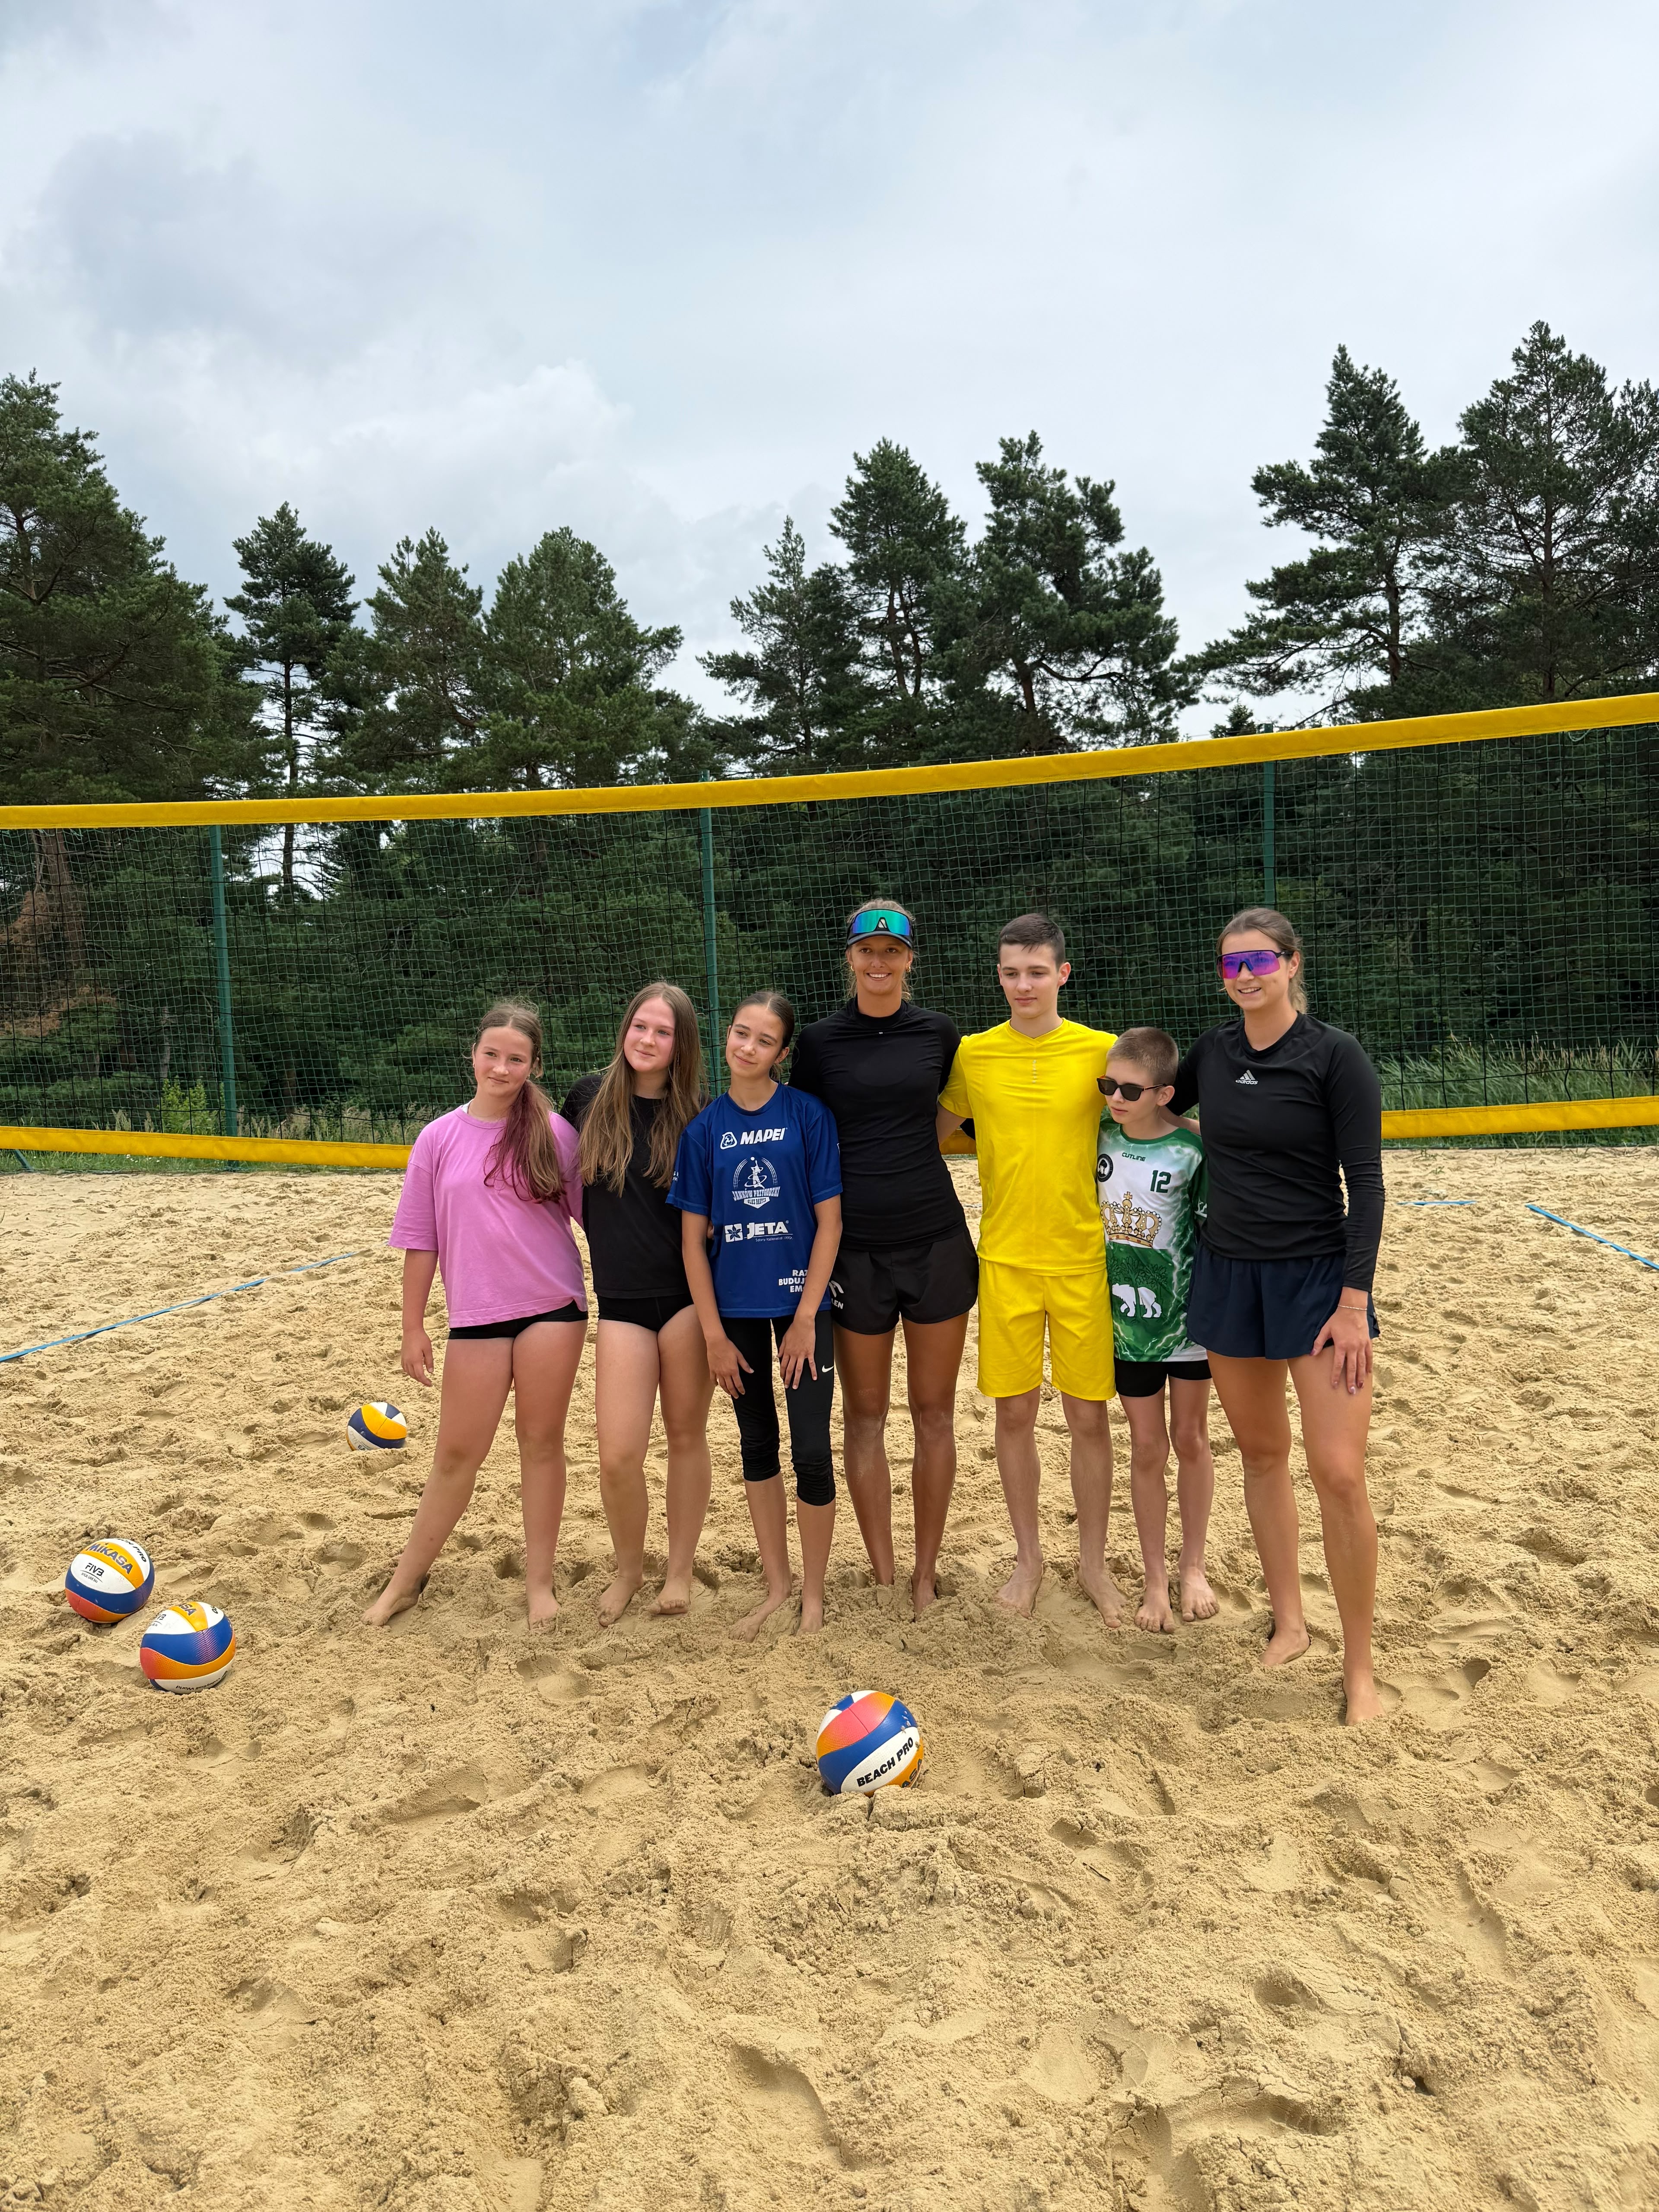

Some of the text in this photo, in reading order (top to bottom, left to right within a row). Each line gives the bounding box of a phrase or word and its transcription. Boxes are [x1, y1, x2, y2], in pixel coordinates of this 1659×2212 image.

[740, 1128, 785, 1145] MAPEI
[1122, 1152, 1146, 1161] CUTLINE
[1150, 1170, 1172, 1193] 12
[753, 1186, 781, 1197] PRZYGODZKI
[747, 1222, 788, 1239] JETA
[779, 1278, 806, 1286] BUDUJ
[86, 1543, 133, 1574] MIKASA
[856, 1737, 913, 1787] BEACH PRO
